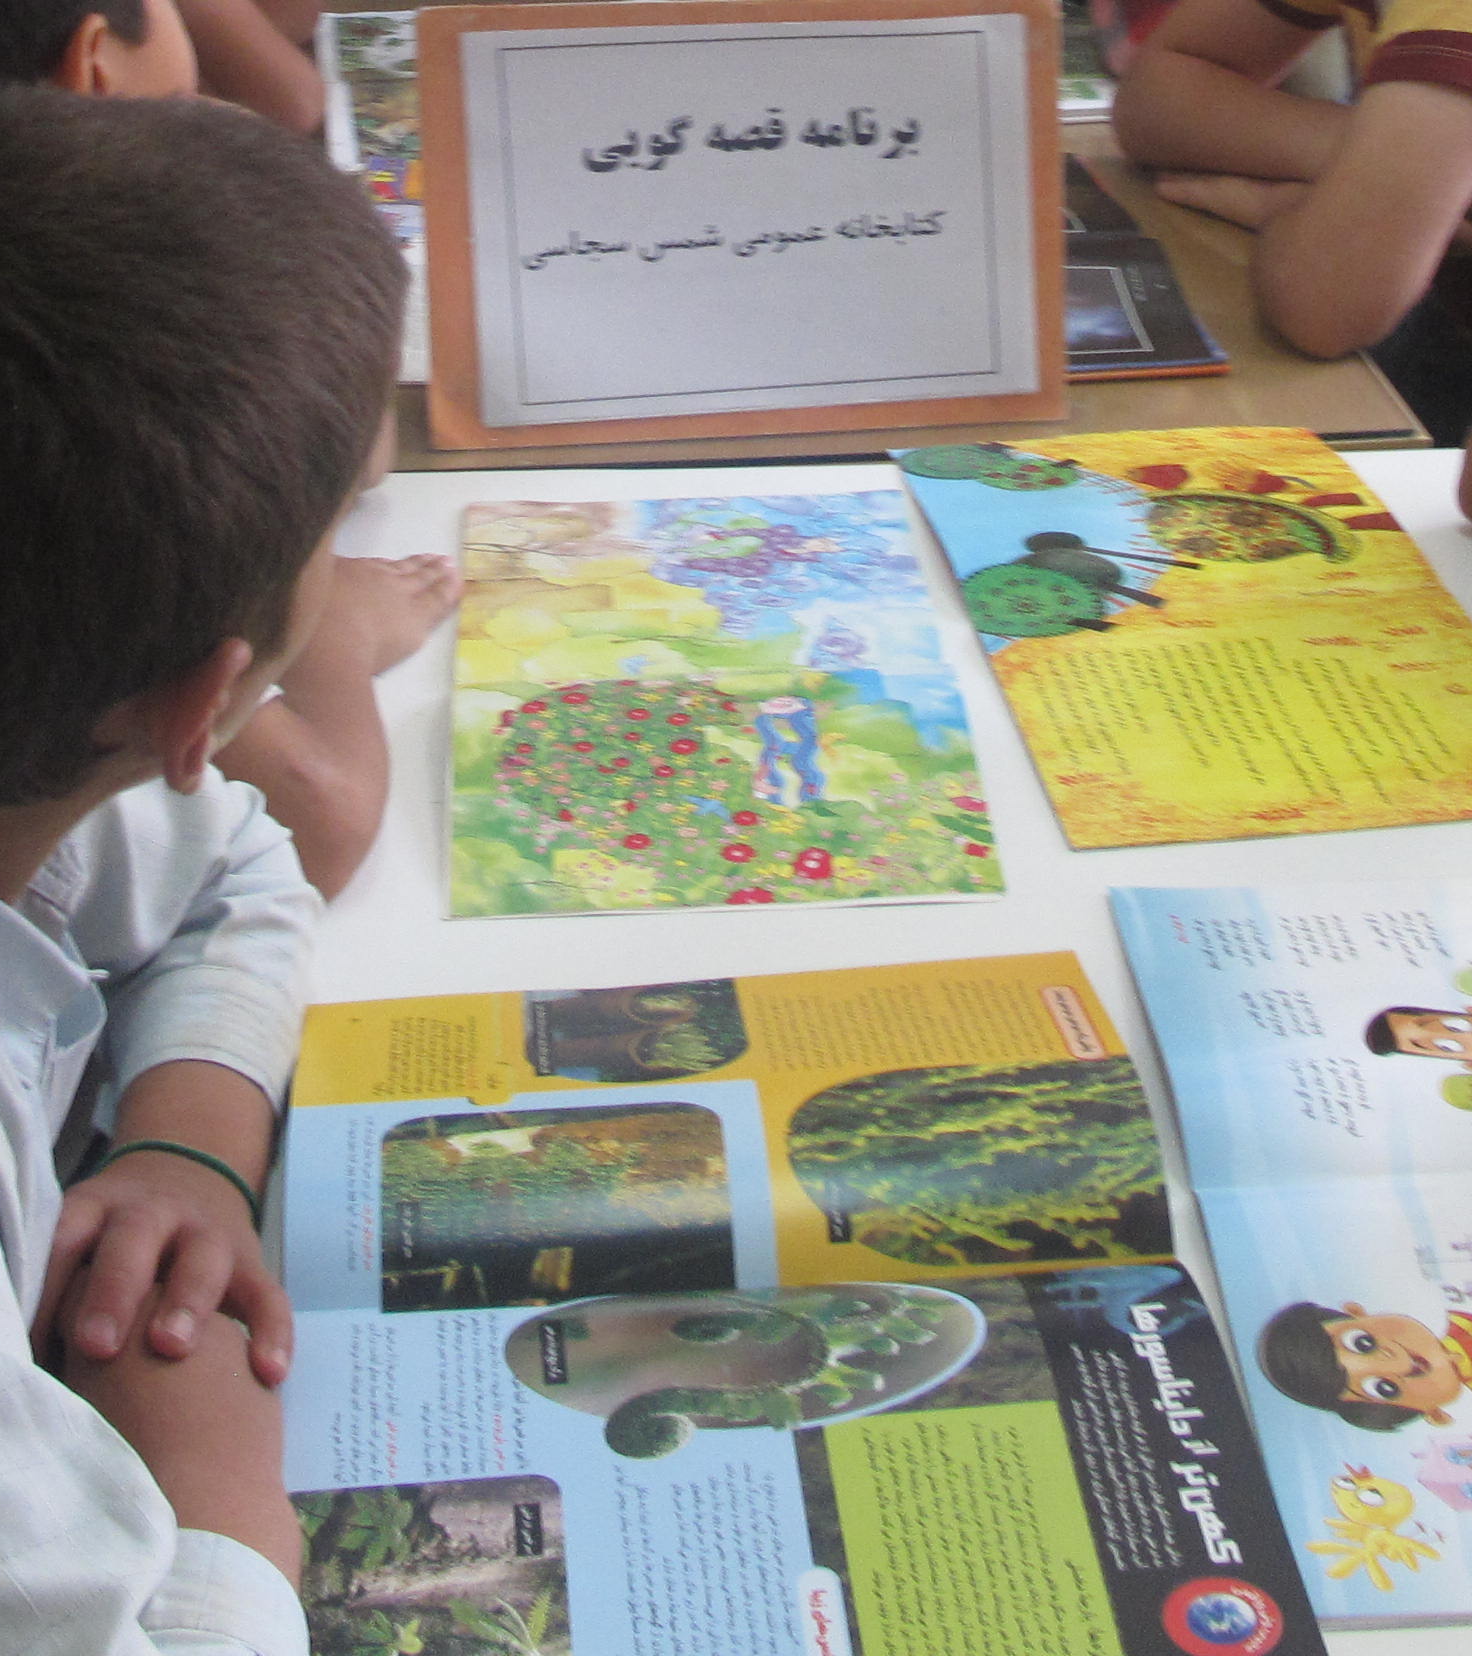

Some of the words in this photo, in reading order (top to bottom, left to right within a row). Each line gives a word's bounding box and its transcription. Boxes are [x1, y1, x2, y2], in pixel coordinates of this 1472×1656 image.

[582, 114, 694, 173] گویی
[704, 106, 785, 152] قصه
[798, 105, 921, 160] برنامه
[637, 223, 725, 263] شمس
[731, 225, 825, 258] عمومی
[835, 209, 948, 246] کتابخانه
[521, 230, 628, 272] سجاسی
